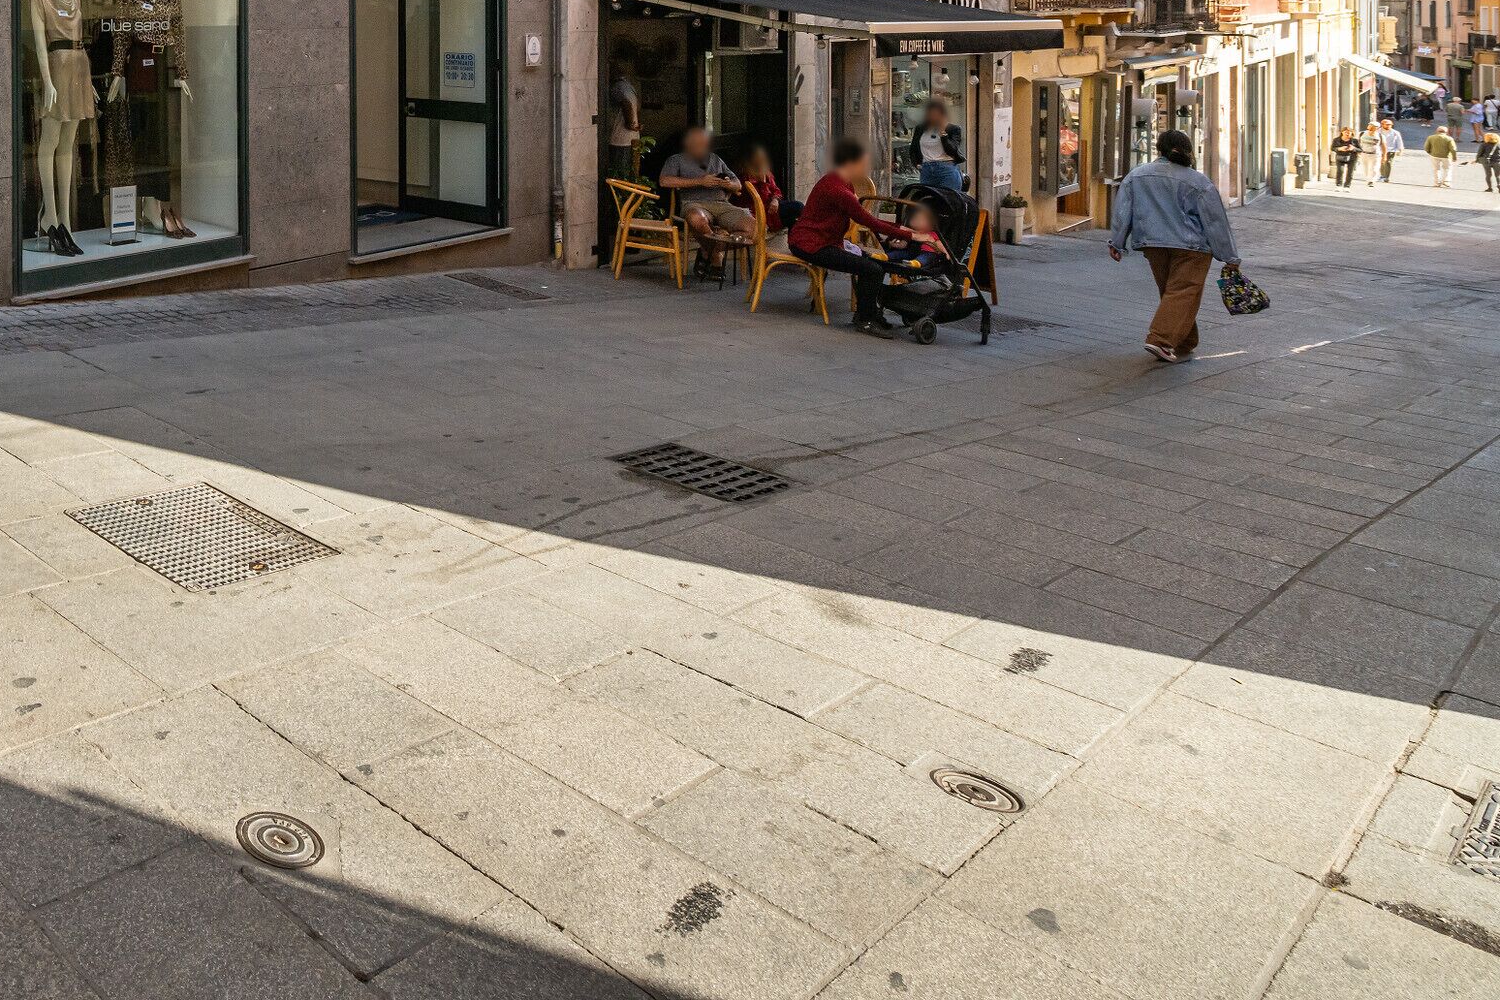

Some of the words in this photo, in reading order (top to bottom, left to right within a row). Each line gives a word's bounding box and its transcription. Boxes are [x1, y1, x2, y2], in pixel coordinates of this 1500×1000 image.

[101, 19, 132, 32] blue
[134, 19, 170, 32] sand
[932, 39, 944, 52] WINE
